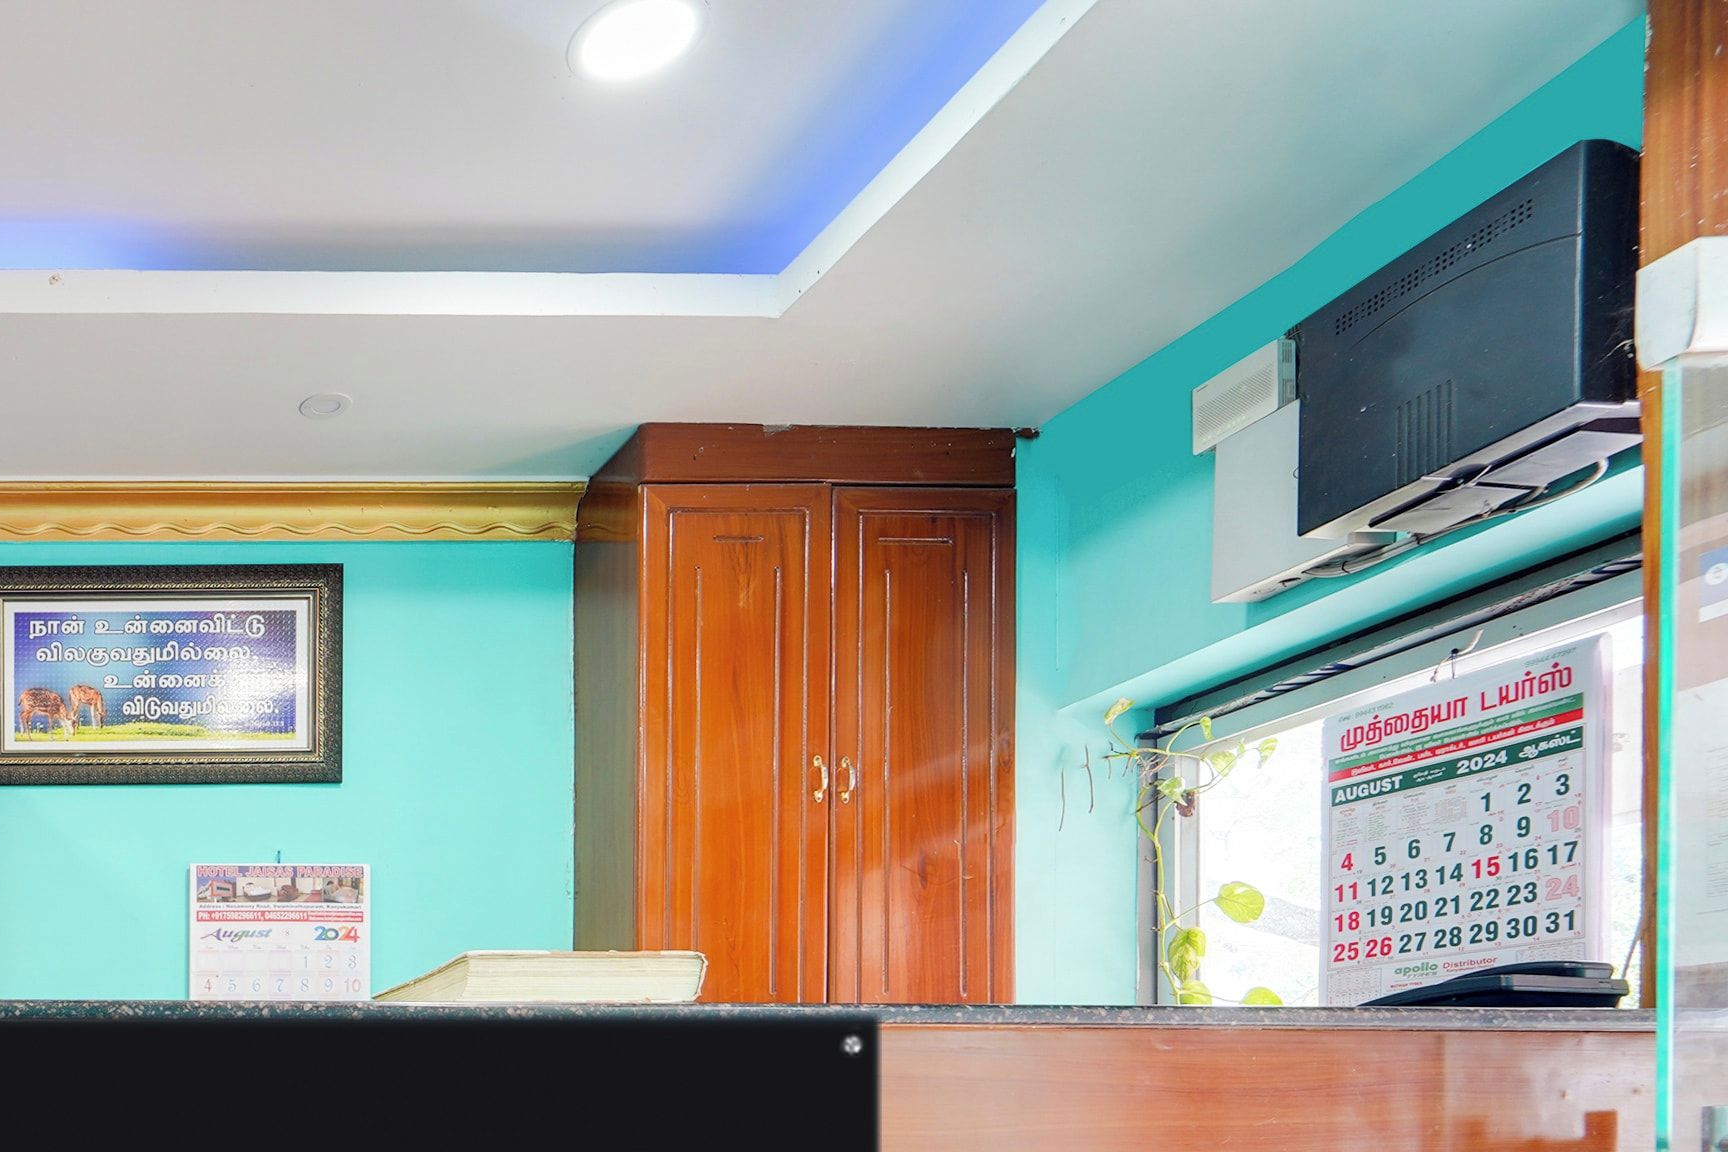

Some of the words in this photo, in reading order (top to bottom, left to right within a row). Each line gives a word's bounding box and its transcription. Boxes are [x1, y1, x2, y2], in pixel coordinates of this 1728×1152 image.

[29, 614, 84, 639] நான்
[1341, 697, 1468, 752] முத்தையா
[1481, 662, 1572, 711] டயர்ஸ்
[1518, 730, 1581, 758] ஆகஸ்ட்
[1334, 775, 1404, 804] AUGUST
[1456, 750, 1508, 775] 2024
[1480, 792, 1491, 812] 1
[1517, 783, 1531, 805] 2
[1555, 774, 1570, 796] 3
[1341, 853, 1353, 871] 4
[1374, 846, 1387, 866] 5
[1408, 839, 1421, 859] 6
[1443, 832, 1456, 852] 7
[1479, 824, 1493, 845] 8
[1517, 816, 1531, 838] 9
[1546, 805, 1580, 832] 10
[197, 866, 243, 878] HOTEL
[296, 866, 362, 878] PARADISE
[1334, 882, 1358, 902] 11
[1367, 876, 1394, 897] 12
[1401, 869, 1428, 891] 13
[1435, 863, 1463, 885] 14
[1471, 856, 1500, 879] 15
[1508, 848, 1539, 872] 16
[1547, 841, 1578, 865] 17
[1334, 911, 1360, 932] 18
[1367, 906, 1393, 927] 19
[1400, 900, 1428, 923] 20
[1434, 895, 1460, 917] 21
[1470, 888, 1500, 912] 22
[1506, 882, 1538, 906] 23
[1544, 874, 1580, 901] 24
[200, 927, 272, 943] August
[314, 925, 360, 943] 2024
[1333, 942, 1359, 963] 25
[1365, 937, 1393, 958] 26
[1398, 932, 1427, 954] 27
[1433, 926, 1462, 949] 28
[1469, 920, 1499, 944] 29
[1506, 915, 1538, 939] 30
[1545, 909, 1575, 933] 31
[325, 955, 333, 969] 2
[348, 955, 357, 969] 3
[1394, 961, 1438, 976] apollo
[1442, 956, 1498, 969] Distributor
[204, 979, 211, 993] 4
[228, 979, 237, 992] 5
[252, 978, 261, 992] 6
[276, 979, 284, 992] 7
[300, 978, 309, 992] 8
[324, 979, 333, 992] 9
[345, 979, 361, 992] 10
